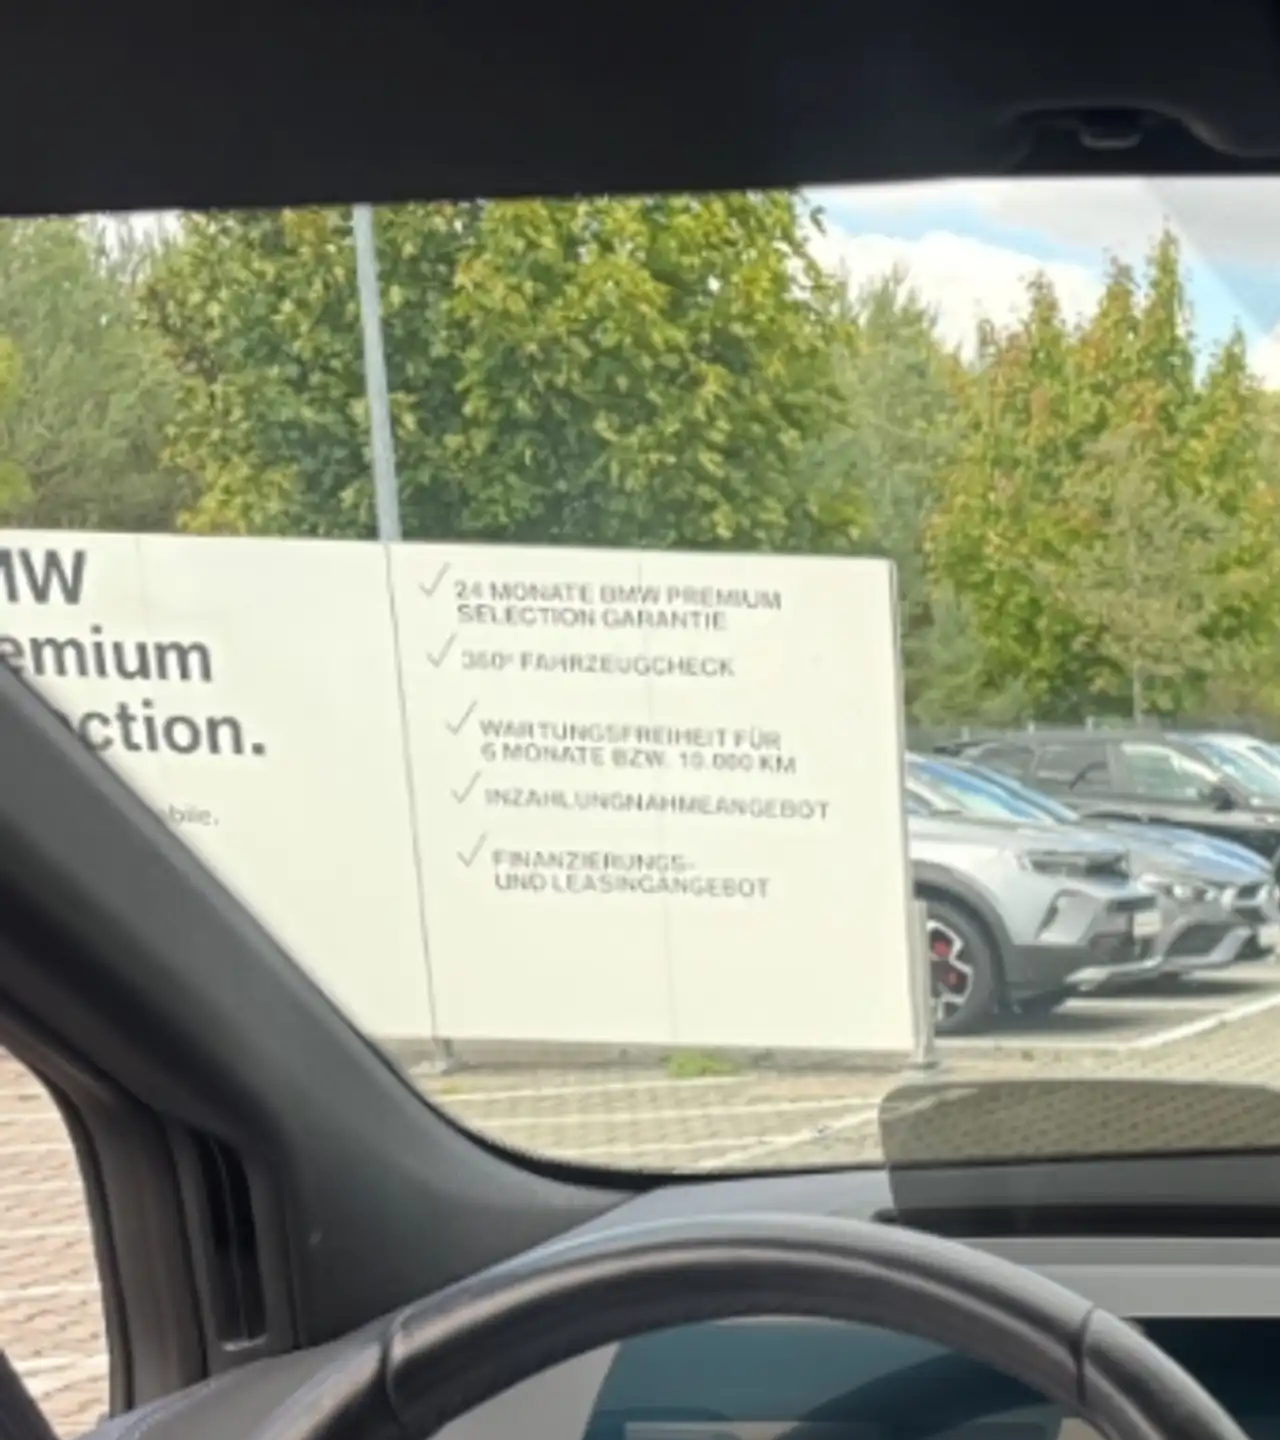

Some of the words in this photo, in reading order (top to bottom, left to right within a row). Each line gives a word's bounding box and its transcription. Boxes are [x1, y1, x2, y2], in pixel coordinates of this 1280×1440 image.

[454, 580, 482, 600] 24
[490, 581, 595, 604] MONATE
[600, 584, 661, 606] BMW
[667, 586, 783, 611] PREMIUM
[457, 603, 597, 627] SELECTION
[601, 607, 728, 631] GARANTIE
[520, 651, 736, 678] FAHRZEUGCHECK
[77, 698, 265, 756] ction.
[478, 718, 727, 748] WARTUNGSFREIHEIT
[733, 725, 782, 751] FÜR
[502, 743, 606, 768] MONATE
[759, 753, 797, 775] KM
[494, 873, 547, 892] UND
[551, 874, 771, 900] LEASINGANGEBOT
